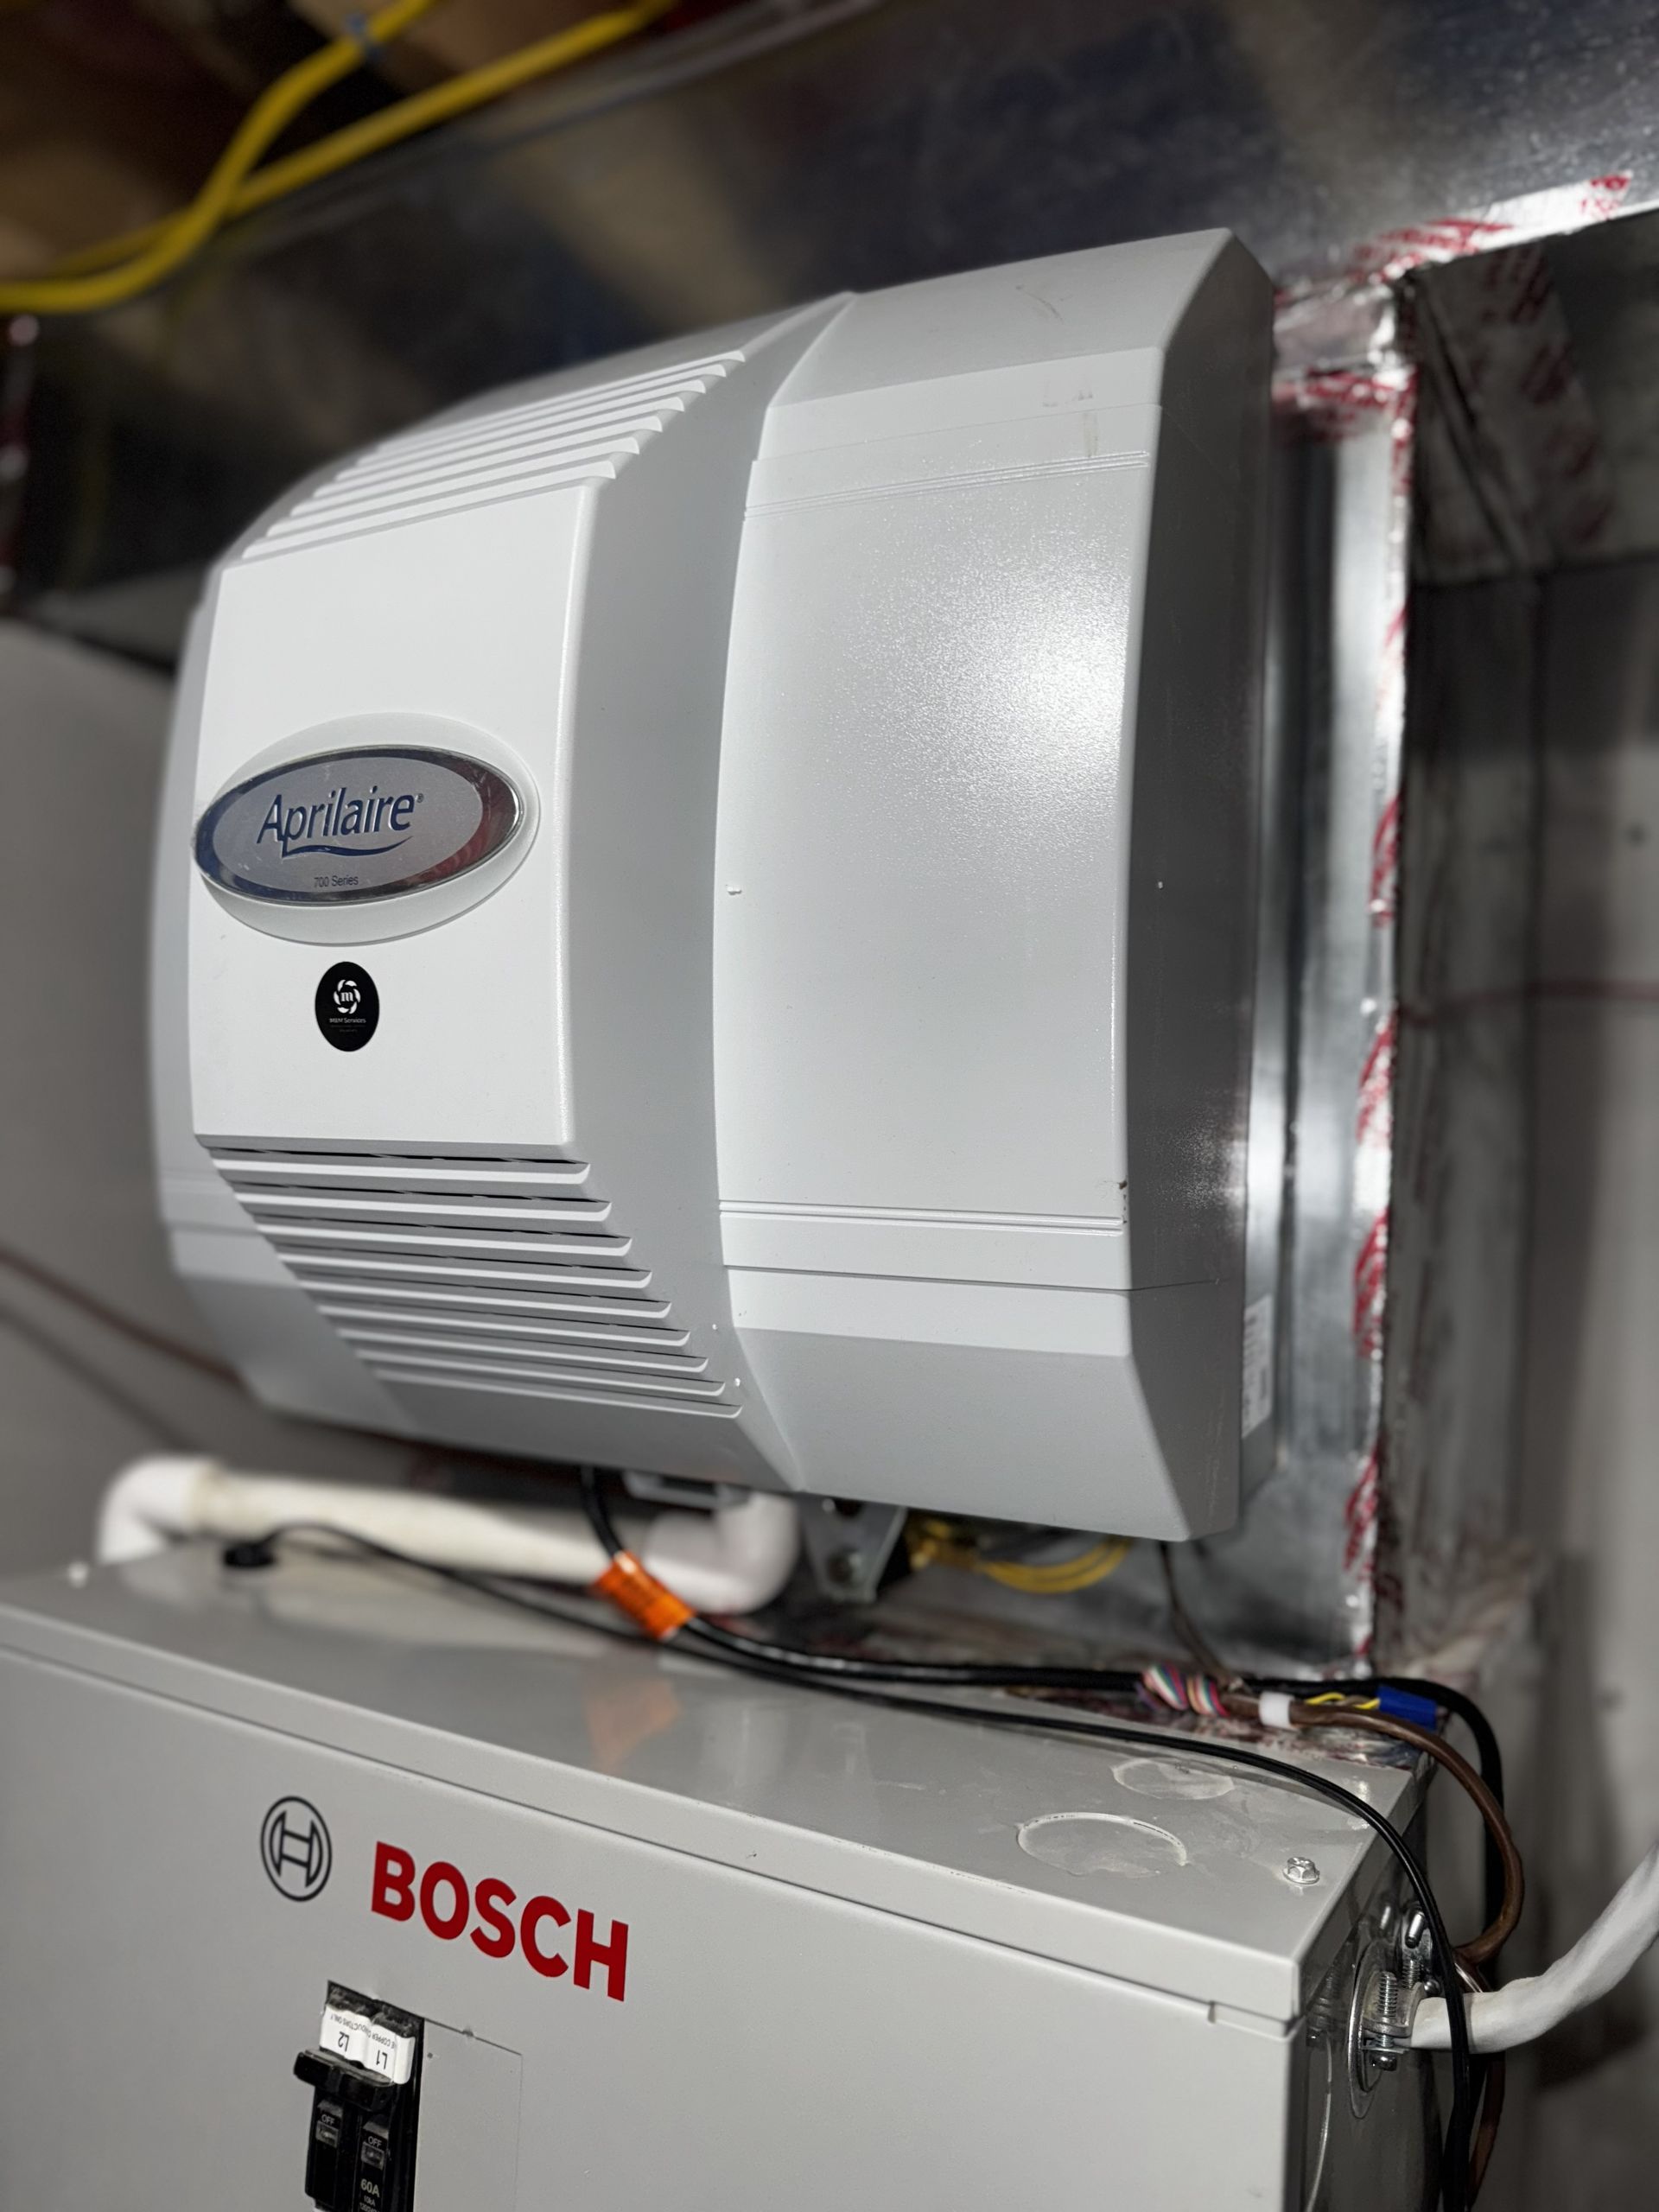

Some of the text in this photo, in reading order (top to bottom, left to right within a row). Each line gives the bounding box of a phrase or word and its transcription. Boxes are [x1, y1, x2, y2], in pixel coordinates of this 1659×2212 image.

[314, 875, 359, 887] 700 Series
[372, 1840, 629, 2002] BOSCH
[338, 2031, 349, 2052] L2
[372, 2032, 391, 2047] COPPER
[376, 2050, 387, 2069] L1
[321, 2114, 335, 2125] OFF
[368, 2136, 382, 2147] OFF
[360, 2178, 379, 2197] 60A
